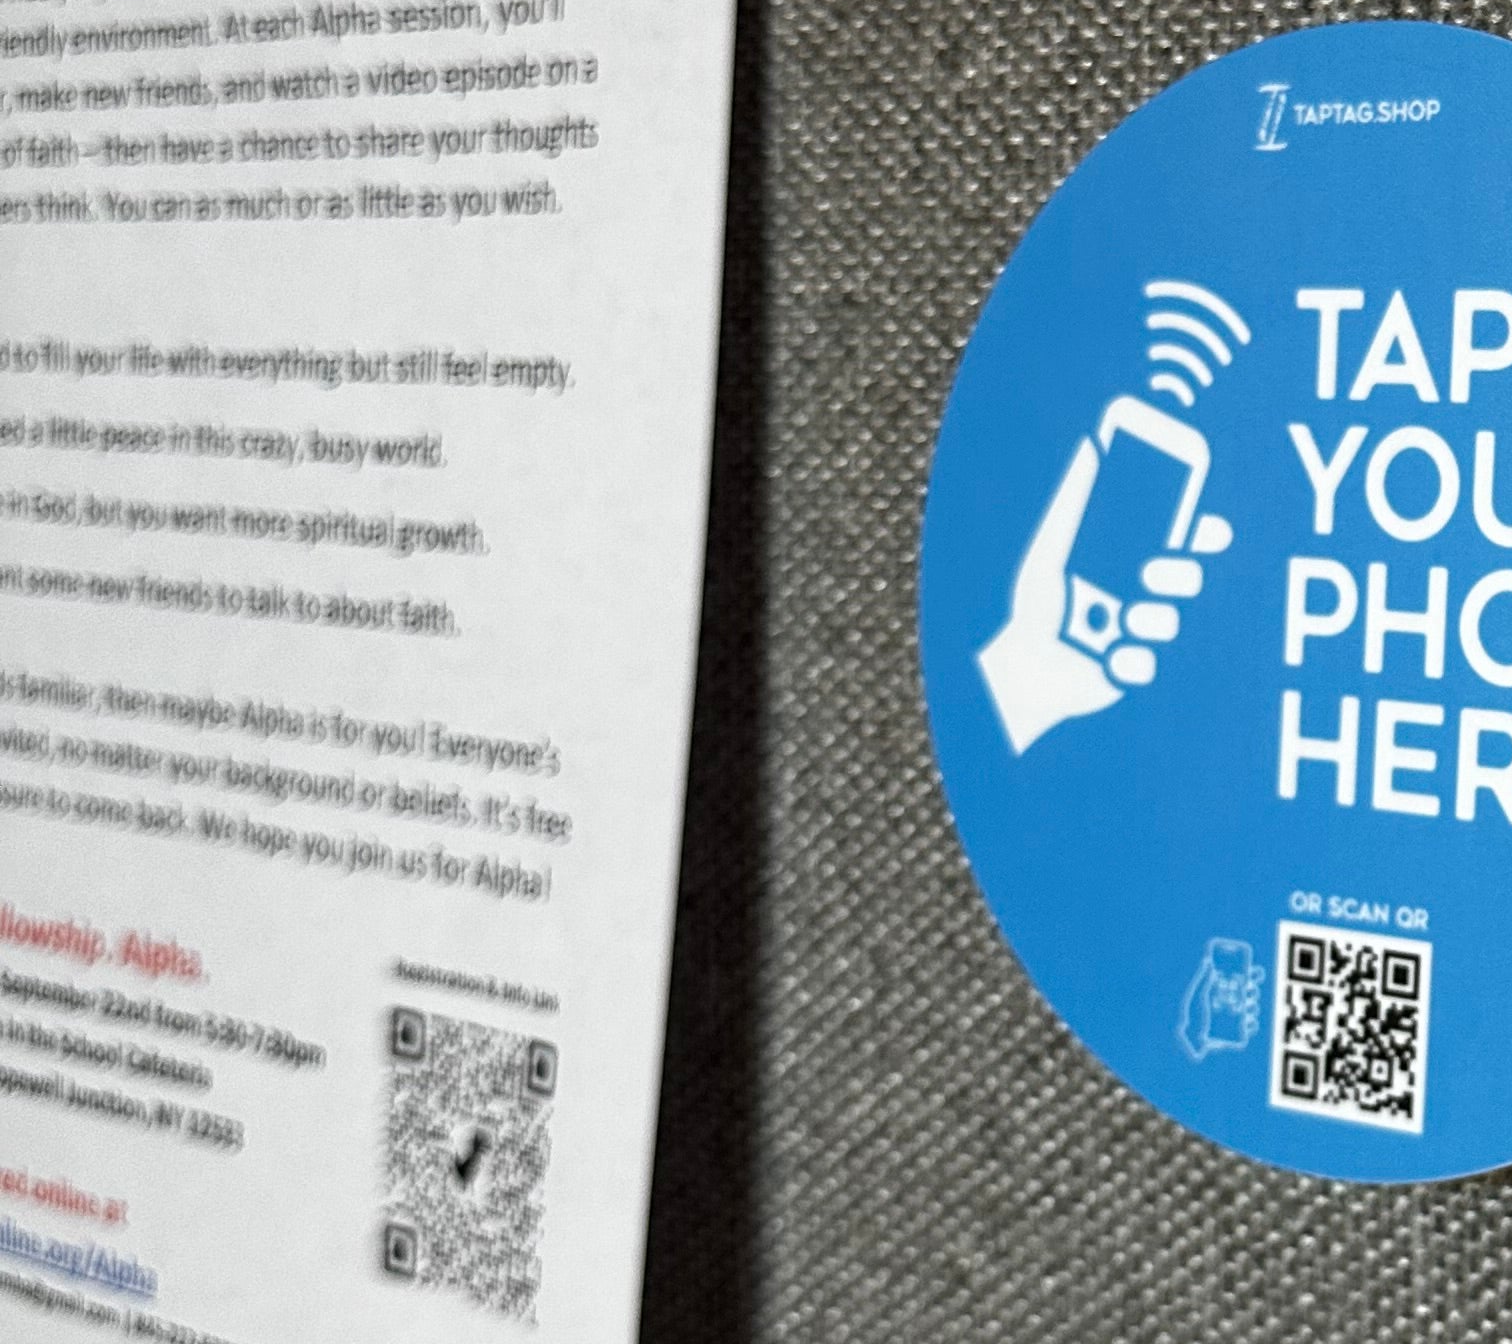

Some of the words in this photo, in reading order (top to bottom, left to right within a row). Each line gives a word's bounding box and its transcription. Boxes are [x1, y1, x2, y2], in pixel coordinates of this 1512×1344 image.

[70, 16, 217, 55] environment.
[251, 7, 305, 42] each
[310, 0, 381, 43] Alpha
[15, 80, 78, 112] make
[81, 84, 130, 111] new
[131, 72, 218, 110] friends,
[220, 68, 265, 104] and
[266, 64, 338, 100] watch
[364, 61, 438, 96] video
[440, 55, 541, 101] episode
[545, 58, 578, 86] on
[1293, 97, 1441, 125] TAPTAG.SHOP
[352, 124, 424, 158] share
[427, 130, 486, 164] your
[491, 113, 599, 159] thoughts
[451, 188, 497, 226] you
[502, 179, 563, 216] wish.
[489, 356, 575, 396] empty.
[1289, 891, 1323, 915] OR
[1327, 896, 1390, 925] SCAN
[1395, 906, 1430, 931] QR
